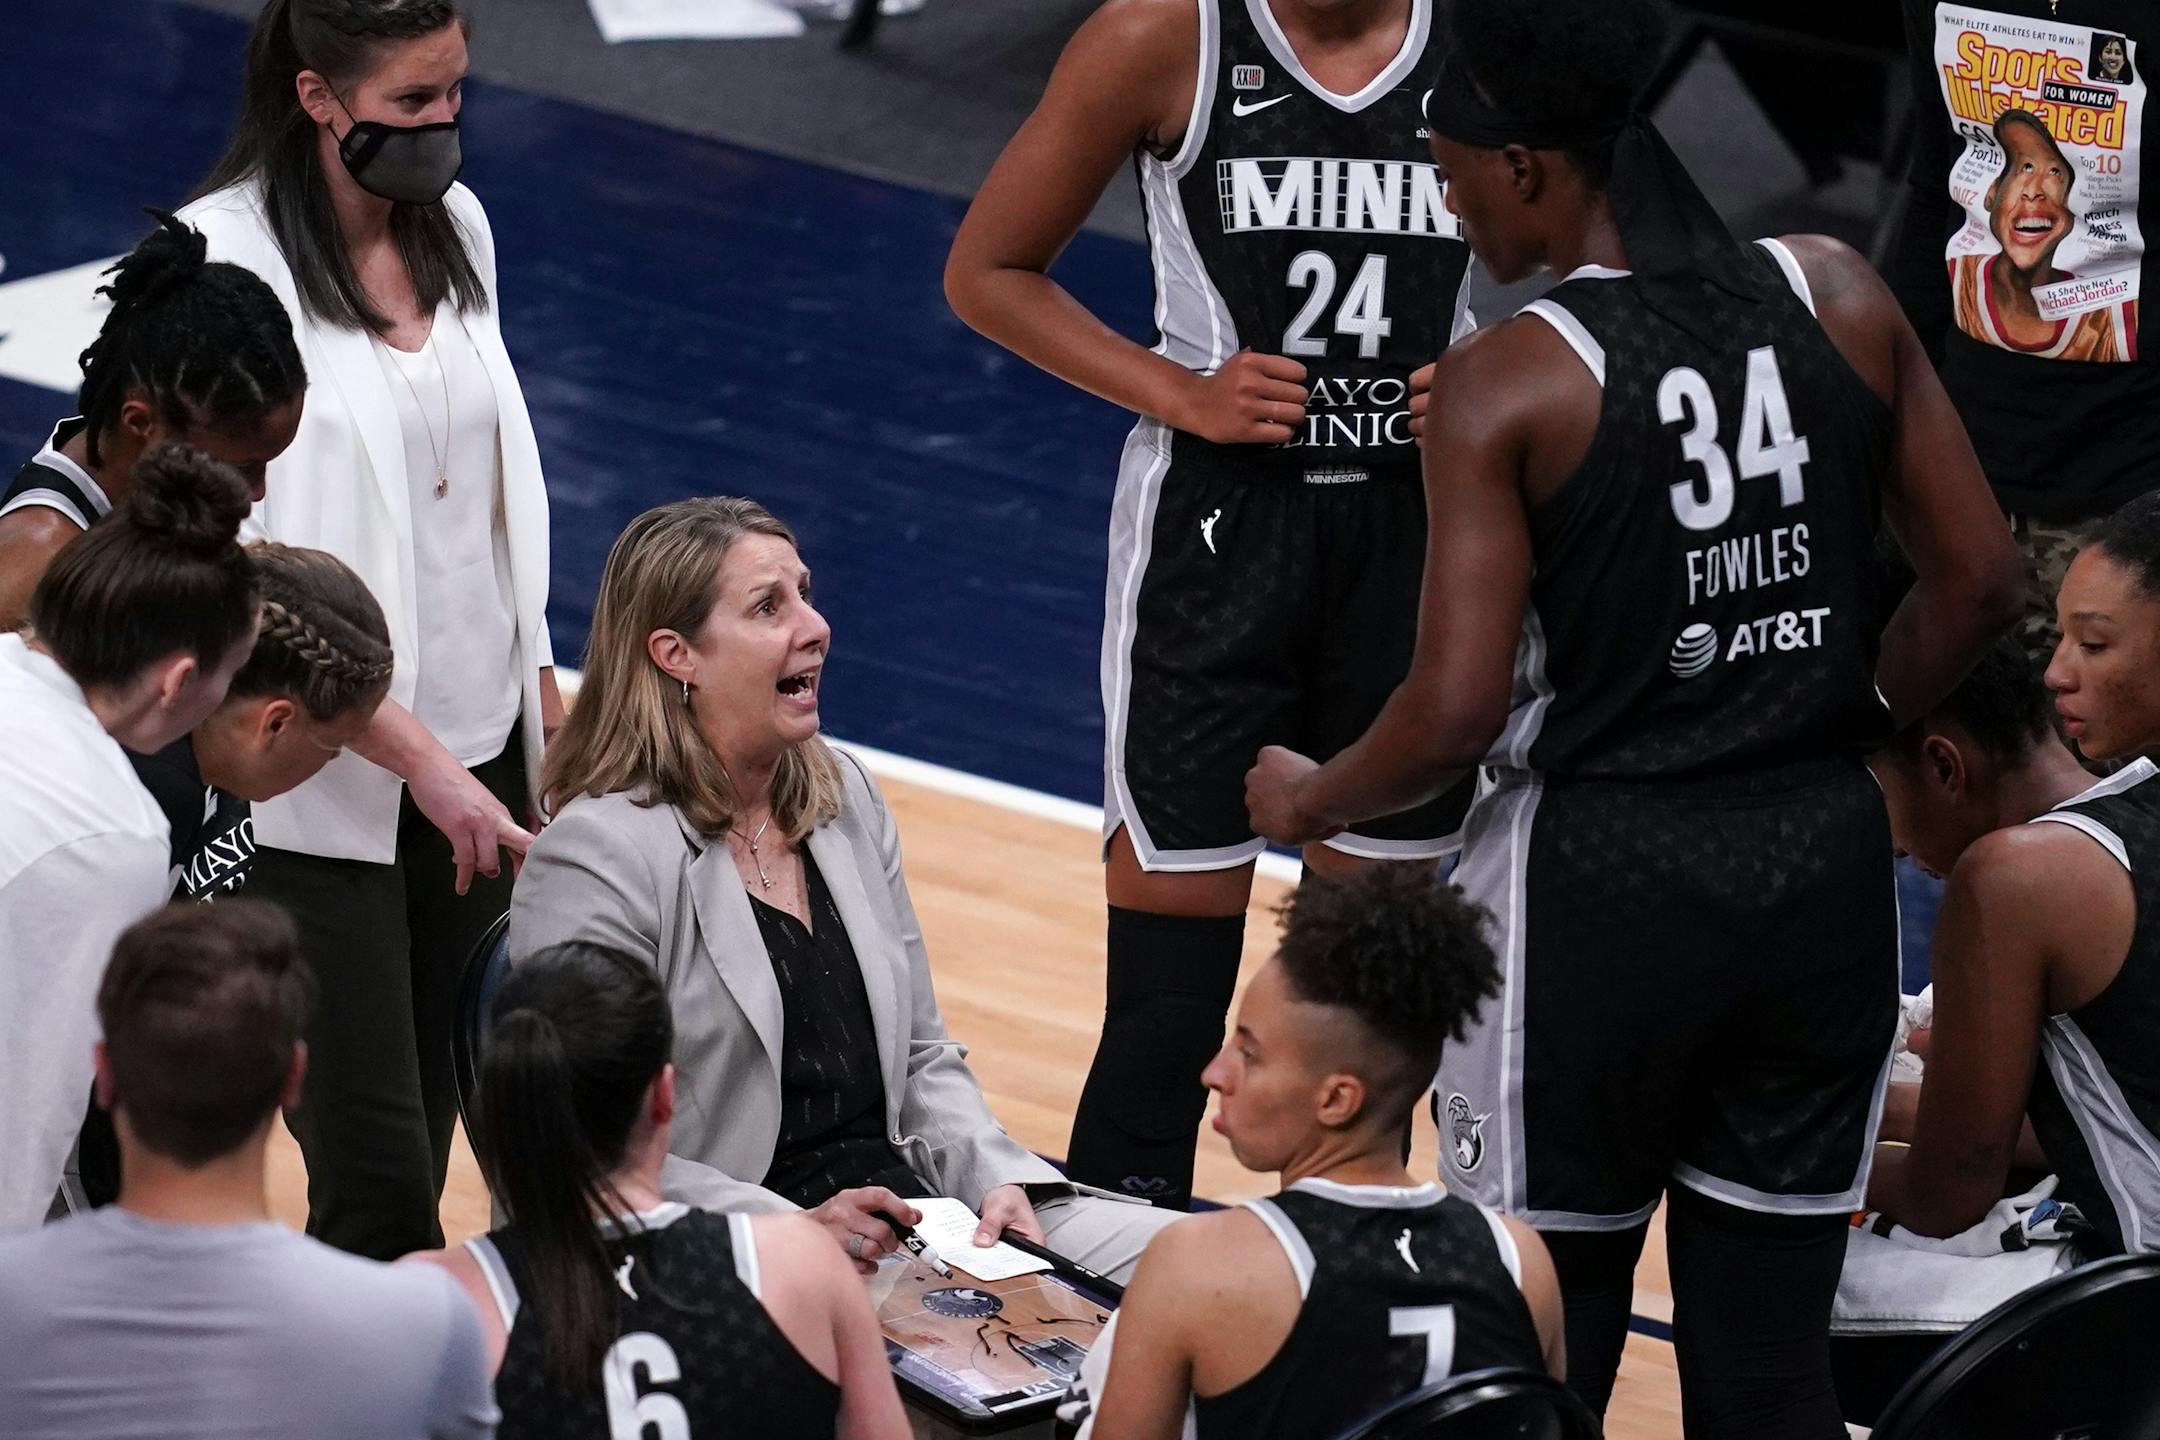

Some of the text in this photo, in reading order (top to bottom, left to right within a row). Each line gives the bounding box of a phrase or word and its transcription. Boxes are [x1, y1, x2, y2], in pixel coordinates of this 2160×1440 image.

[1944, 15, 2075, 46] WHAT ELITE ATHLETES EAT TO WIN
[1956, 31, 2083, 93] Sports
[2045, 85, 2114, 106] FOR WOMEN
[2080, 154, 2122, 175] Top 10
[1230, 159, 1461, 238] MINN
[2084, 207, 2120, 224] March
[1282, 250, 1393, 359] 24
[2047, 278, 2114, 299] Is She the Next
[2081, 280, 2128, 303] Jordan?
[1305, 377, 1406, 407] AYO
[1283, 410, 1415, 449] INIC
[1656, 345, 1811, 531] 34
[1305, 473, 1369, 484] MINNESOTA
[1686, 523, 1811, 606] FOWLES
[1726, 607, 1831, 663] AT&T
[1388, 1304, 1456, 1387] 7
[603, 1331, 692, 1440] 6
